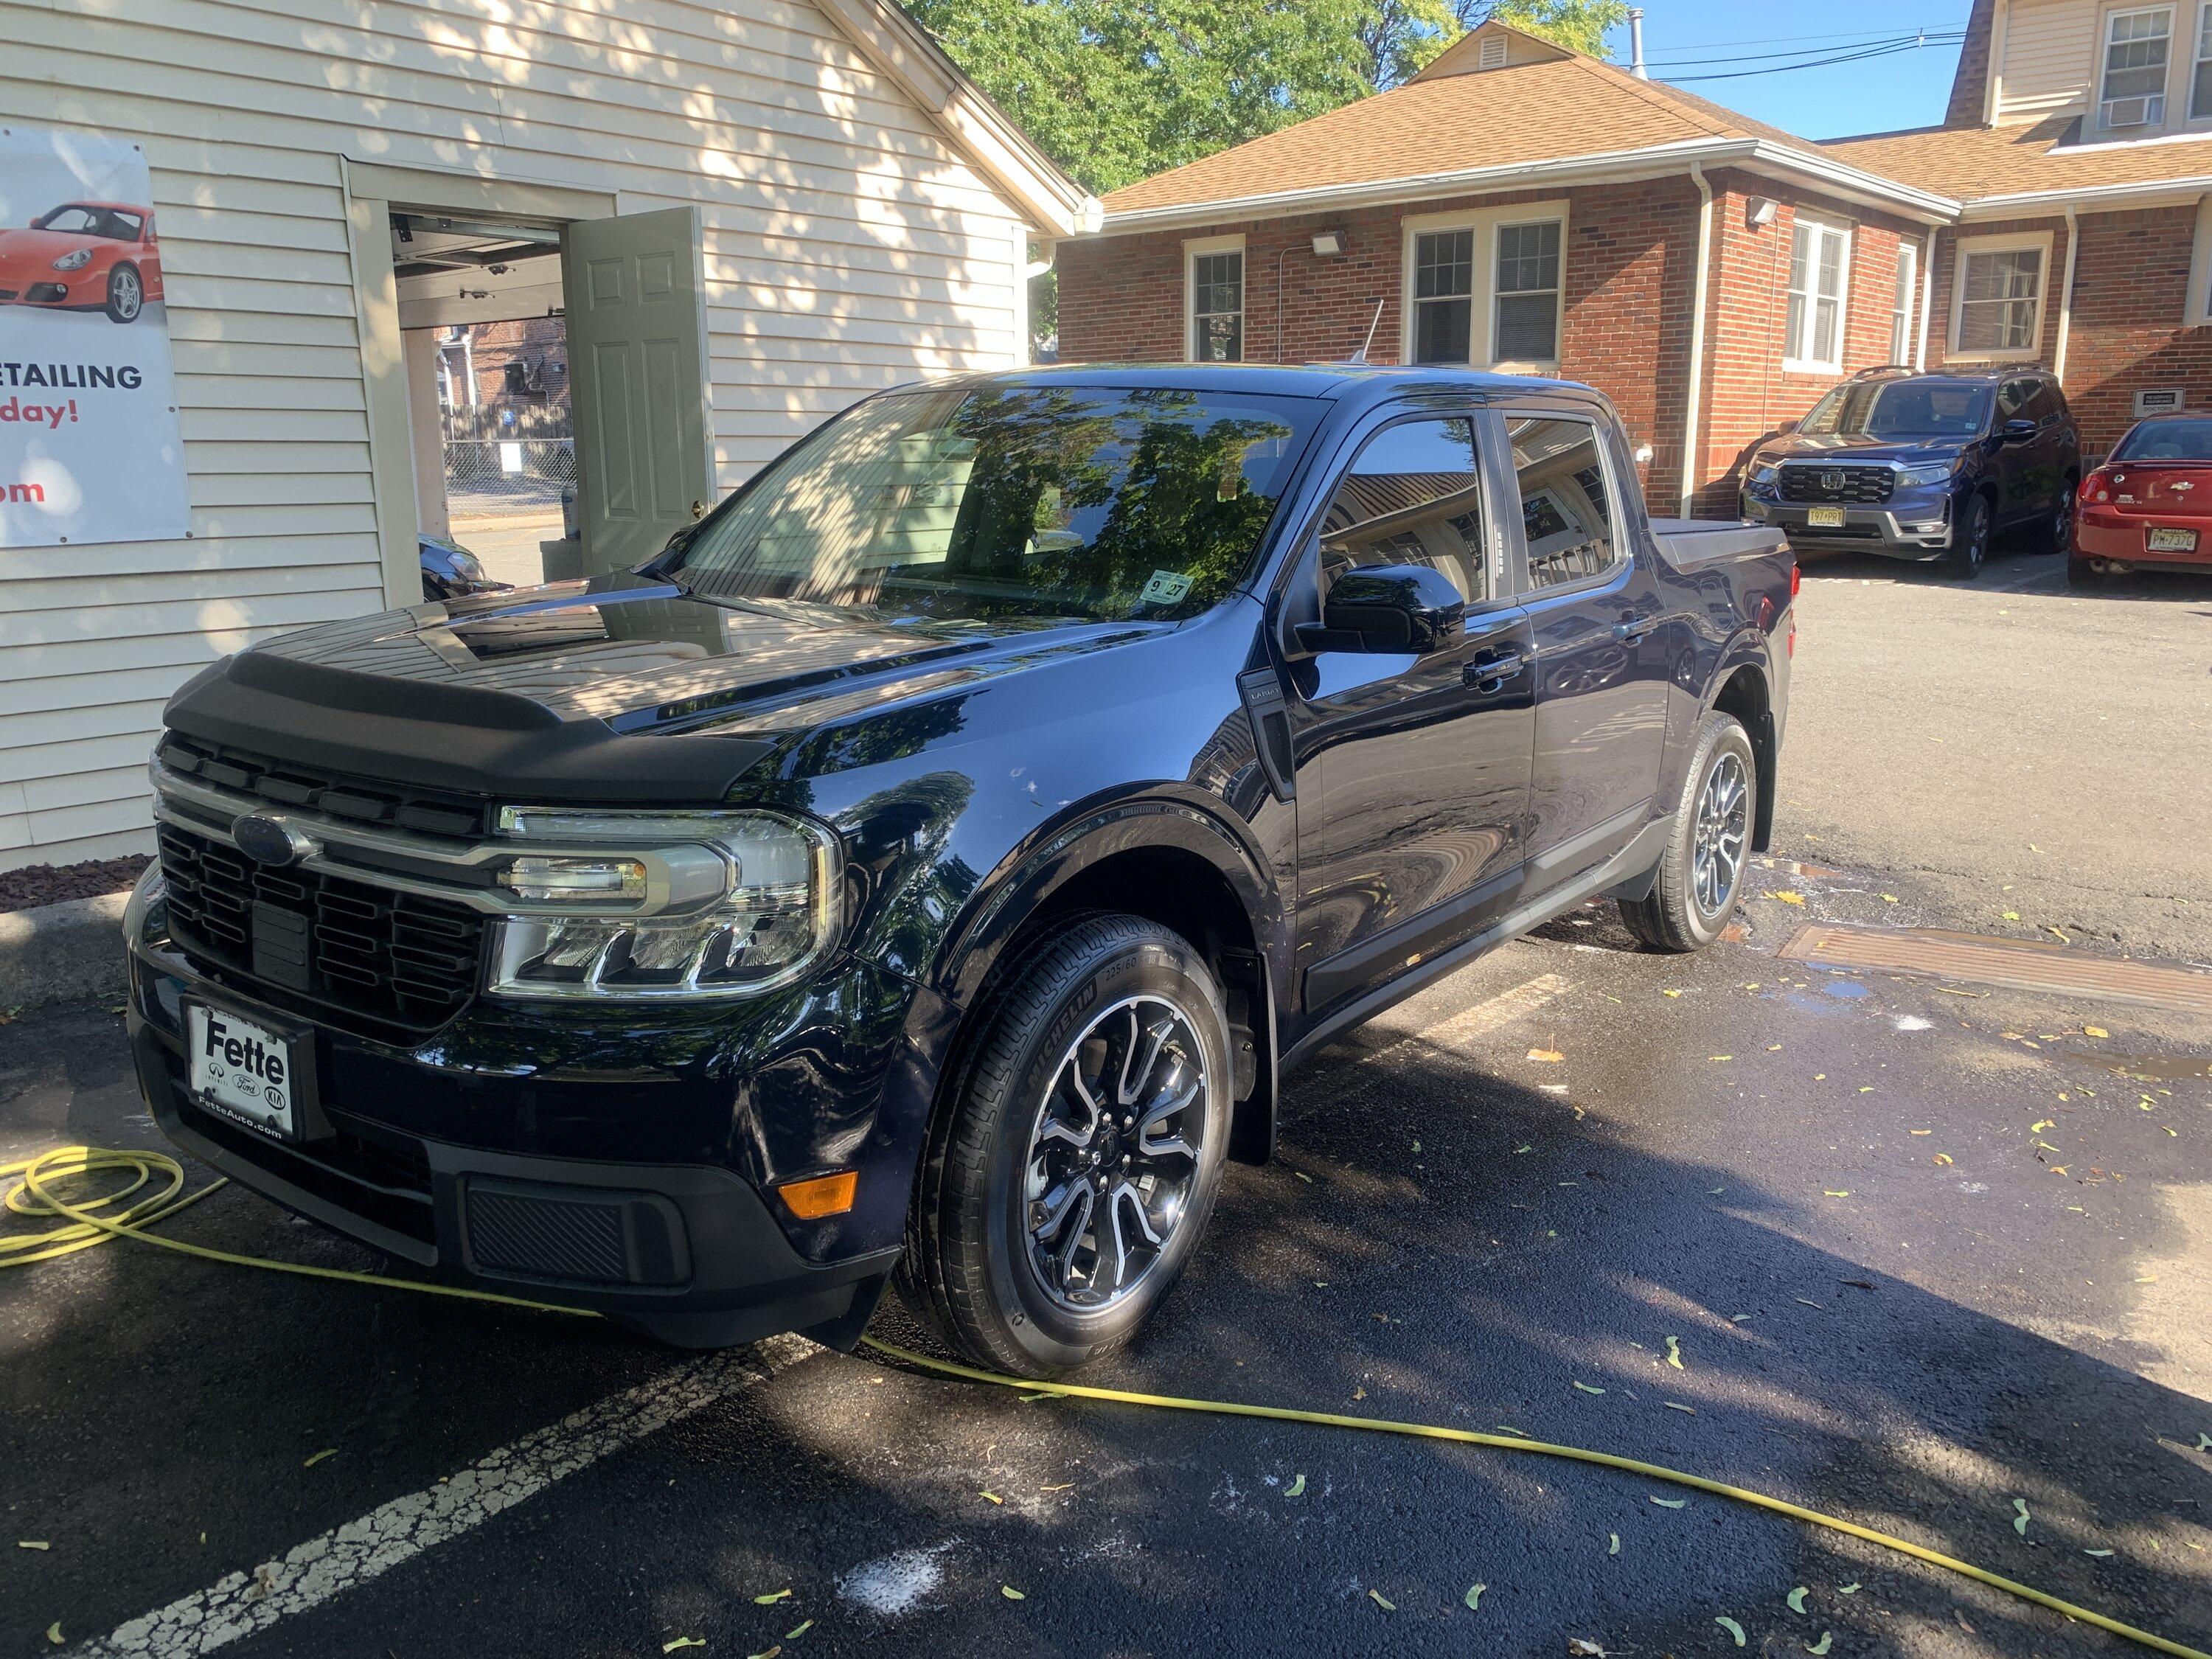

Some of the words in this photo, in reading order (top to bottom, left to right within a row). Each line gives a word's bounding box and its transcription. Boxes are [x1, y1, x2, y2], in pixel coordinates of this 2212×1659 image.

[0, 363, 142, 389] TAILING
[0, 396, 78, 429] day!
[1150, 580, 1161, 593] 9
[1165, 584, 1185, 597] 27
[1028, 984, 1095, 1089] MICHELIN
[206, 1020, 284, 1085] Fette
[237, 1076, 256, 1095] Ford
[268, 1090, 282, 1107] KIA
[198, 1096, 282, 1139] FetteAuto.com
